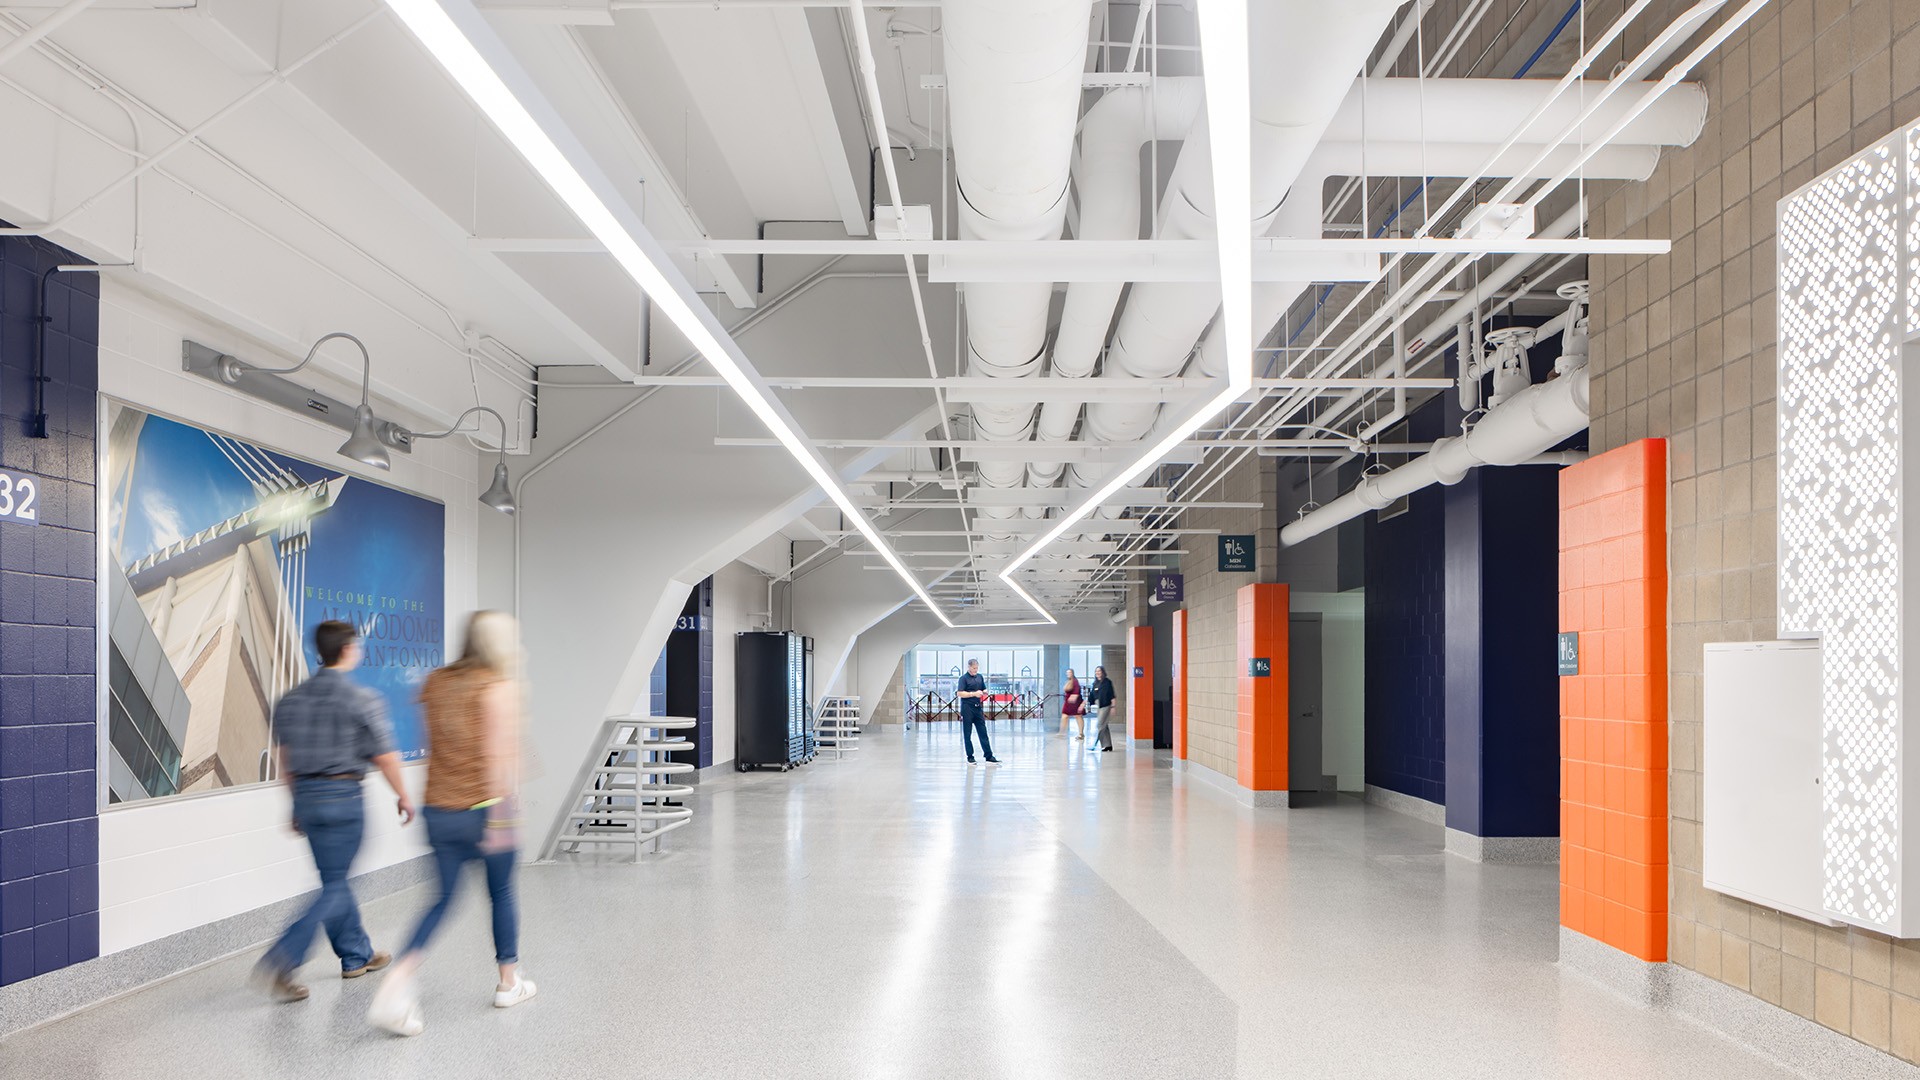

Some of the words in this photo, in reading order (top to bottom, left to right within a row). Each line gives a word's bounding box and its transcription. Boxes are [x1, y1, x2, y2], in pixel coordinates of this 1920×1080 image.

[0, 473, 35, 520] 32
[305, 586, 373, 606] WELCOME
[381, 596, 396, 609] TO
[404, 599, 425, 612] THE
[362, 645, 440, 668] ANTONIO
